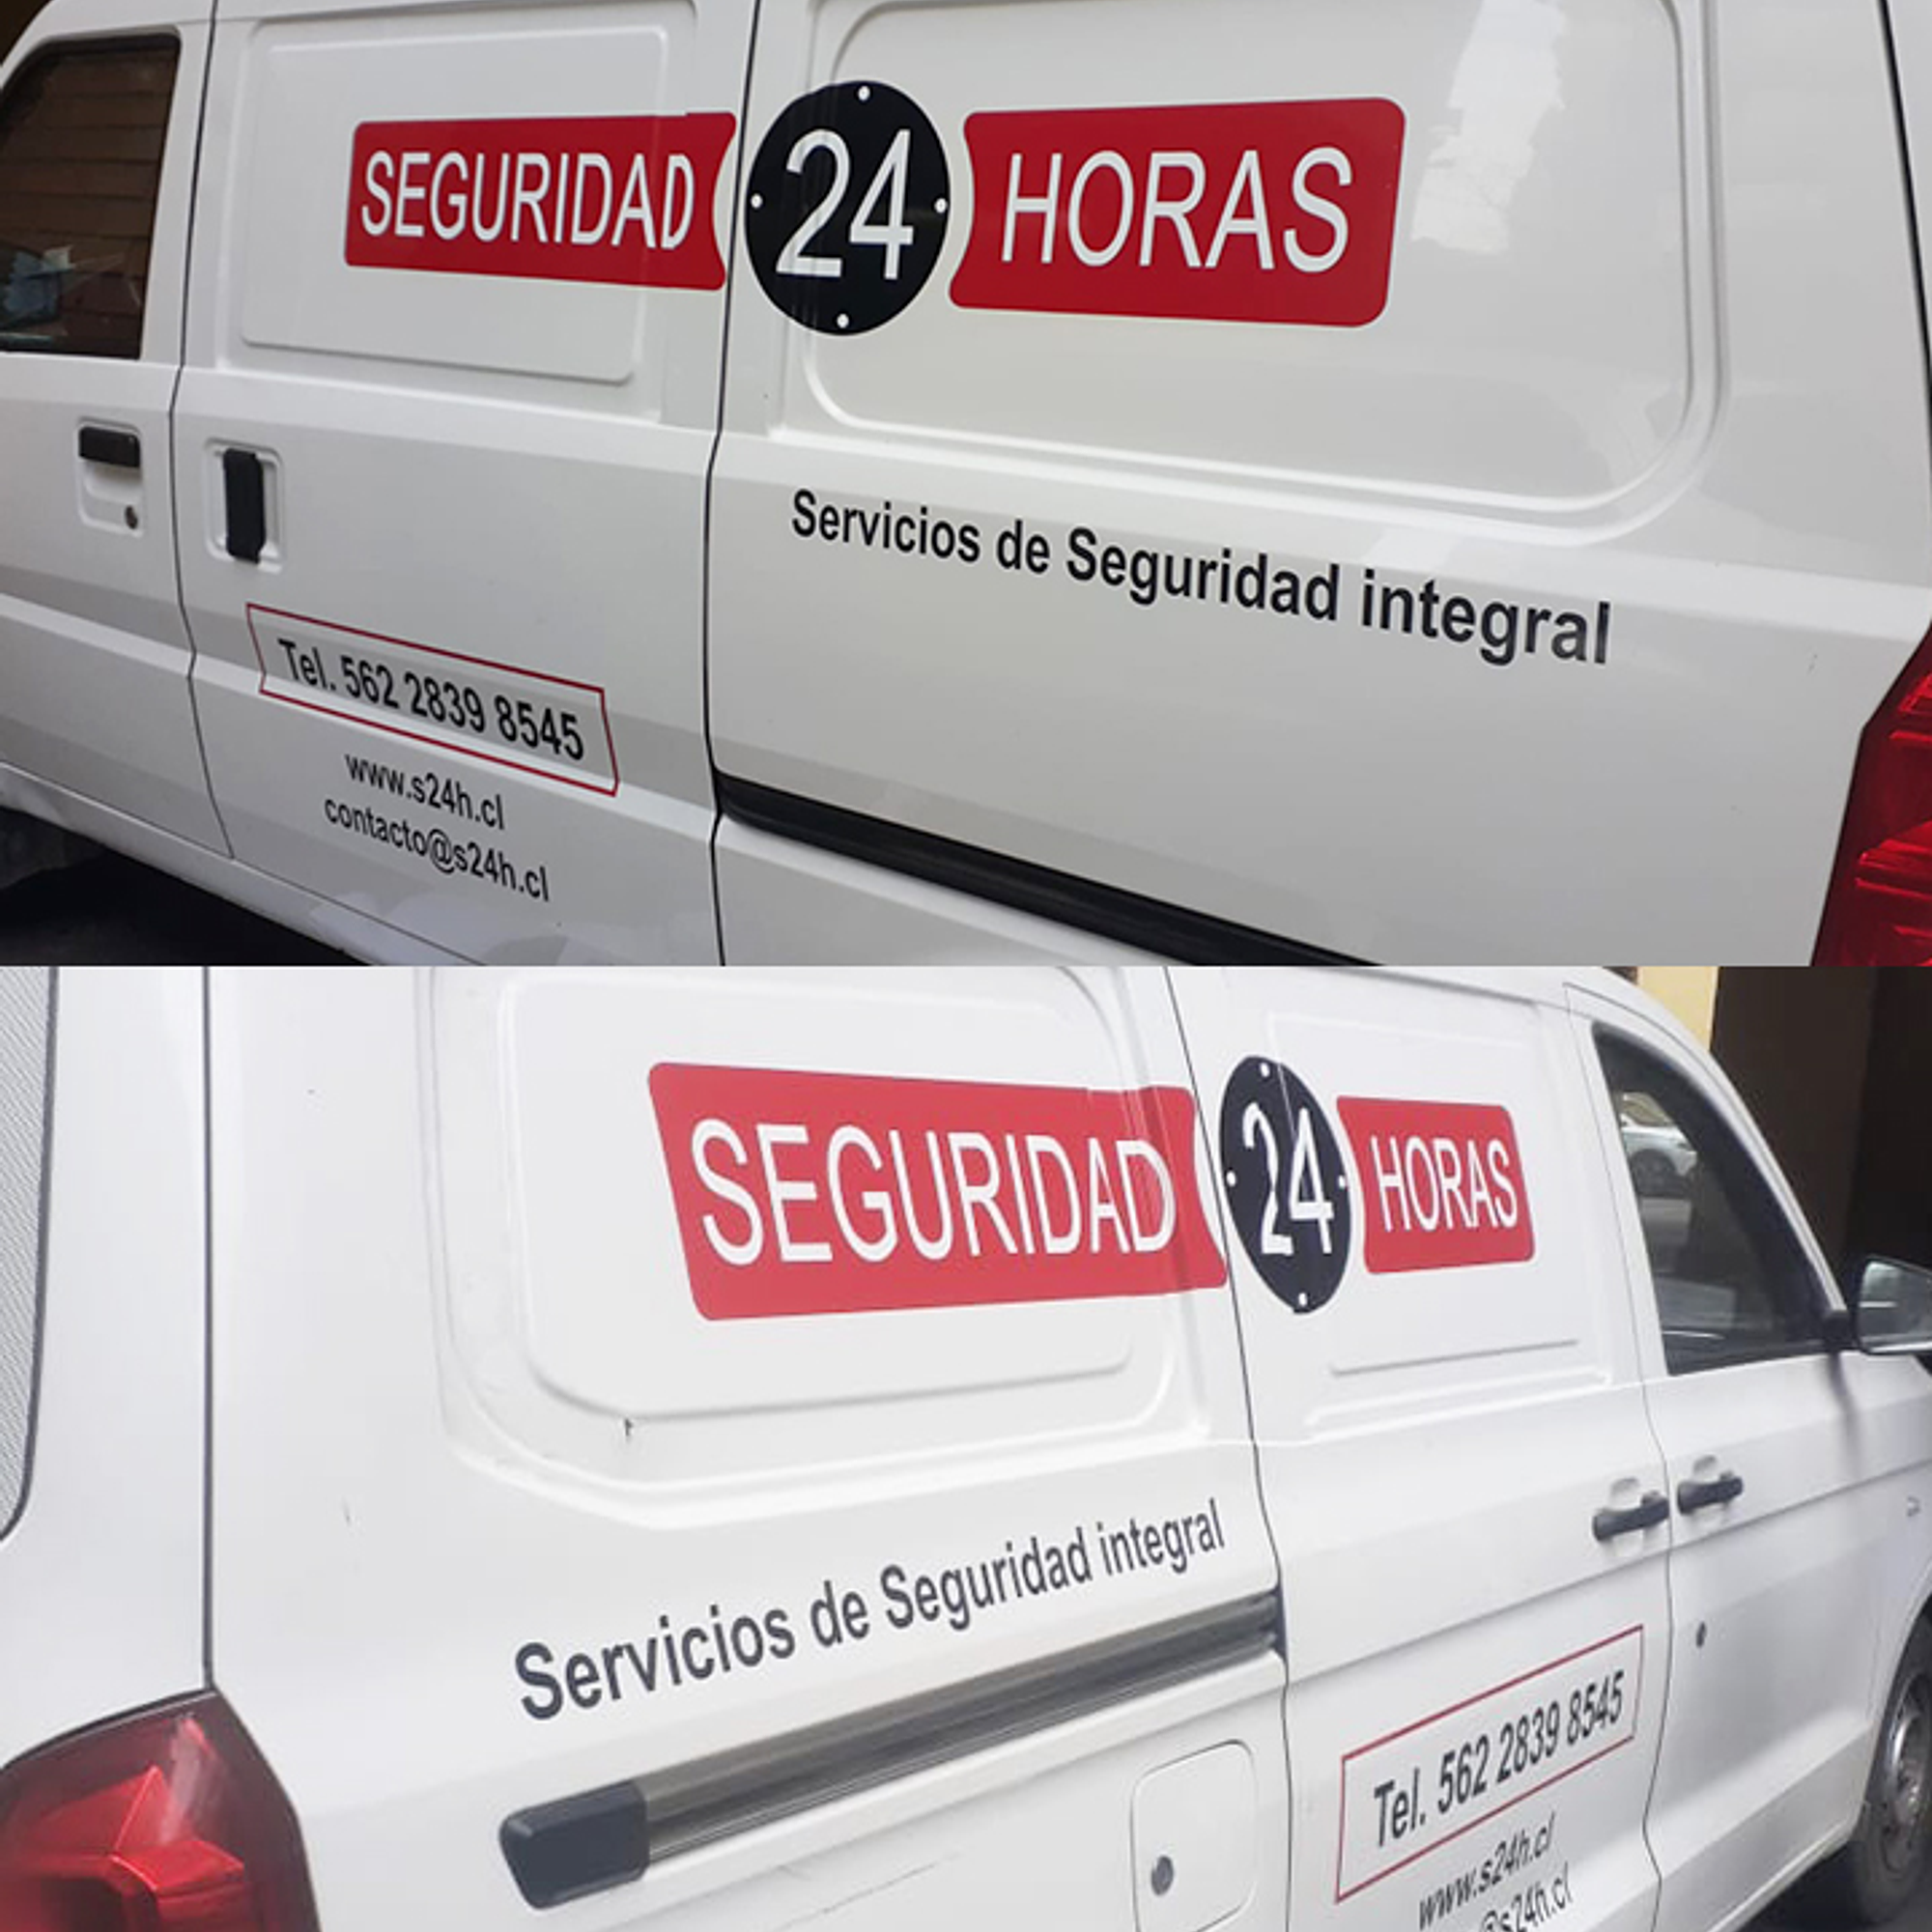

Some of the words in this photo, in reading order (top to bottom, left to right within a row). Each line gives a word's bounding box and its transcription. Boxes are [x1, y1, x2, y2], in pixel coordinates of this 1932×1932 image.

[361, 151, 695, 249] SEGURIDAD
[776, 128, 915, 281] 24
[1001, 146, 1352, 273] HORAS
[792, 489, 980, 565] Servicios
[996, 520, 1050, 574] de
[1066, 526, 1339, 622] Seguridad
[1361, 568, 1611, 667] integral
[277, 637, 336, 692] Tel.
[340, 654, 400, 709] 562
[404, 671, 486, 733] 2839
[494, 694, 584, 760] 8545
[324, 797, 550, 902] contacto@s24h.cl
[344, 753, 505, 830] www.s24h.cl
[691, 1119, 1176, 1265] SEGURIDAD
[1242, 1102, 1334, 1255] 24
[1371, 1135, 1519, 1232] HORAS
[514, 1604, 795, 1720] Servicios
[810, 1580, 868, 1647] de
[879, 1526, 1092, 1630] Seguridad
[1096, 1498, 1225, 1576] integral
[1374, 1768, 1426, 1847] Tel.
[1437, 1736, 1491, 1814] 562
[1496, 1701, 1560, 1784] 2839
[1567, 1670, 1625, 1747] 8545
[1418, 1810, 1556, 1931] www.s24h.cl
